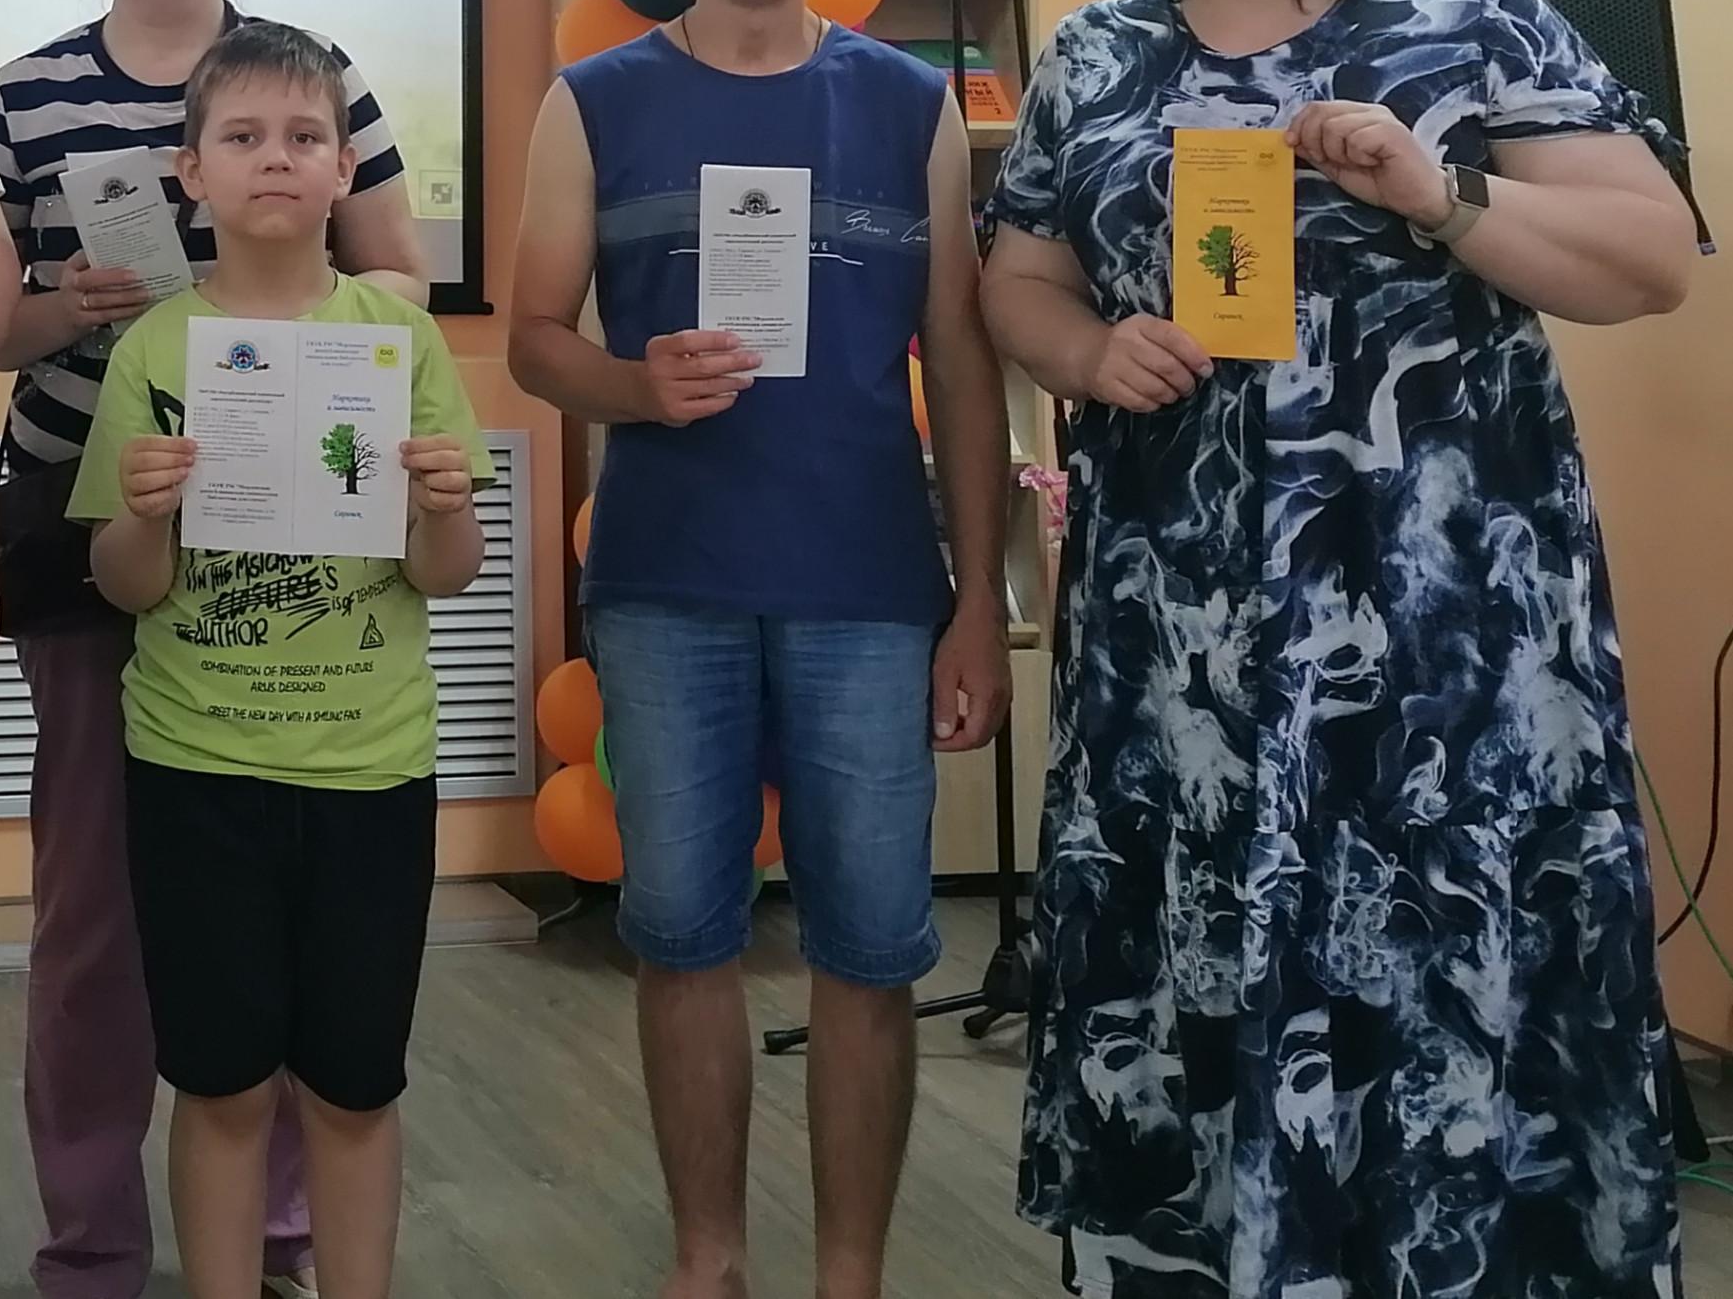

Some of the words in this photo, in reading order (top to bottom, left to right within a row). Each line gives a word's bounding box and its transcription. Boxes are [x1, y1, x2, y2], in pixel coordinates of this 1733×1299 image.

[195, 617, 268, 647] AUTHOR
[263, 665, 278, 677] OF
[279, 664, 320, 677] PRESENT
[322, 664, 343, 676] AND
